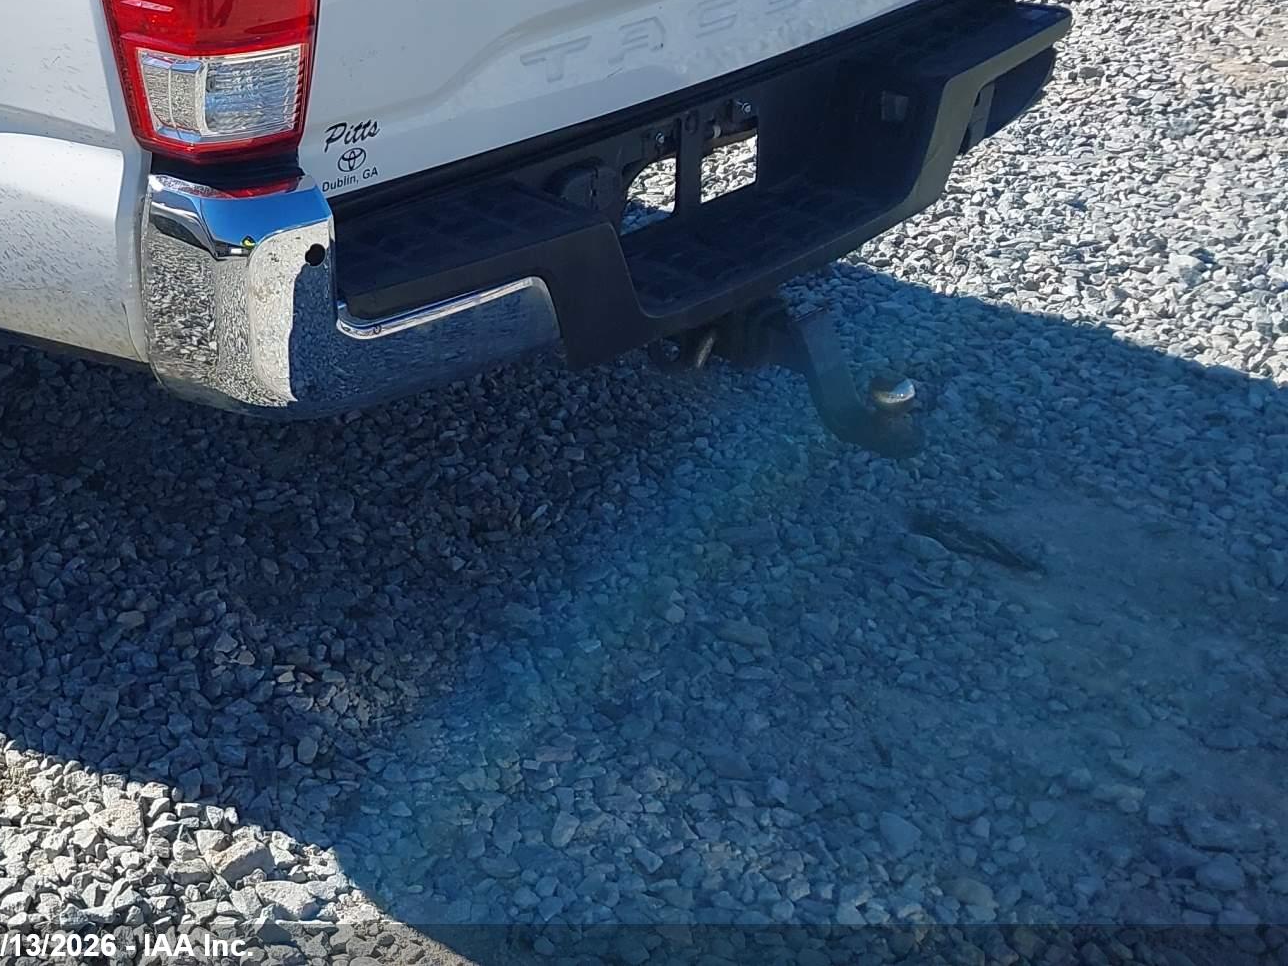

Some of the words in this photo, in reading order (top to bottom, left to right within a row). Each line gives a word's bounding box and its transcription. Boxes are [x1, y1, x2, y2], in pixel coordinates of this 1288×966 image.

[324, 119, 380, 153] Pitts
[322, 174, 359, 192] Dublin,
[362, 166, 378, 179] GA
